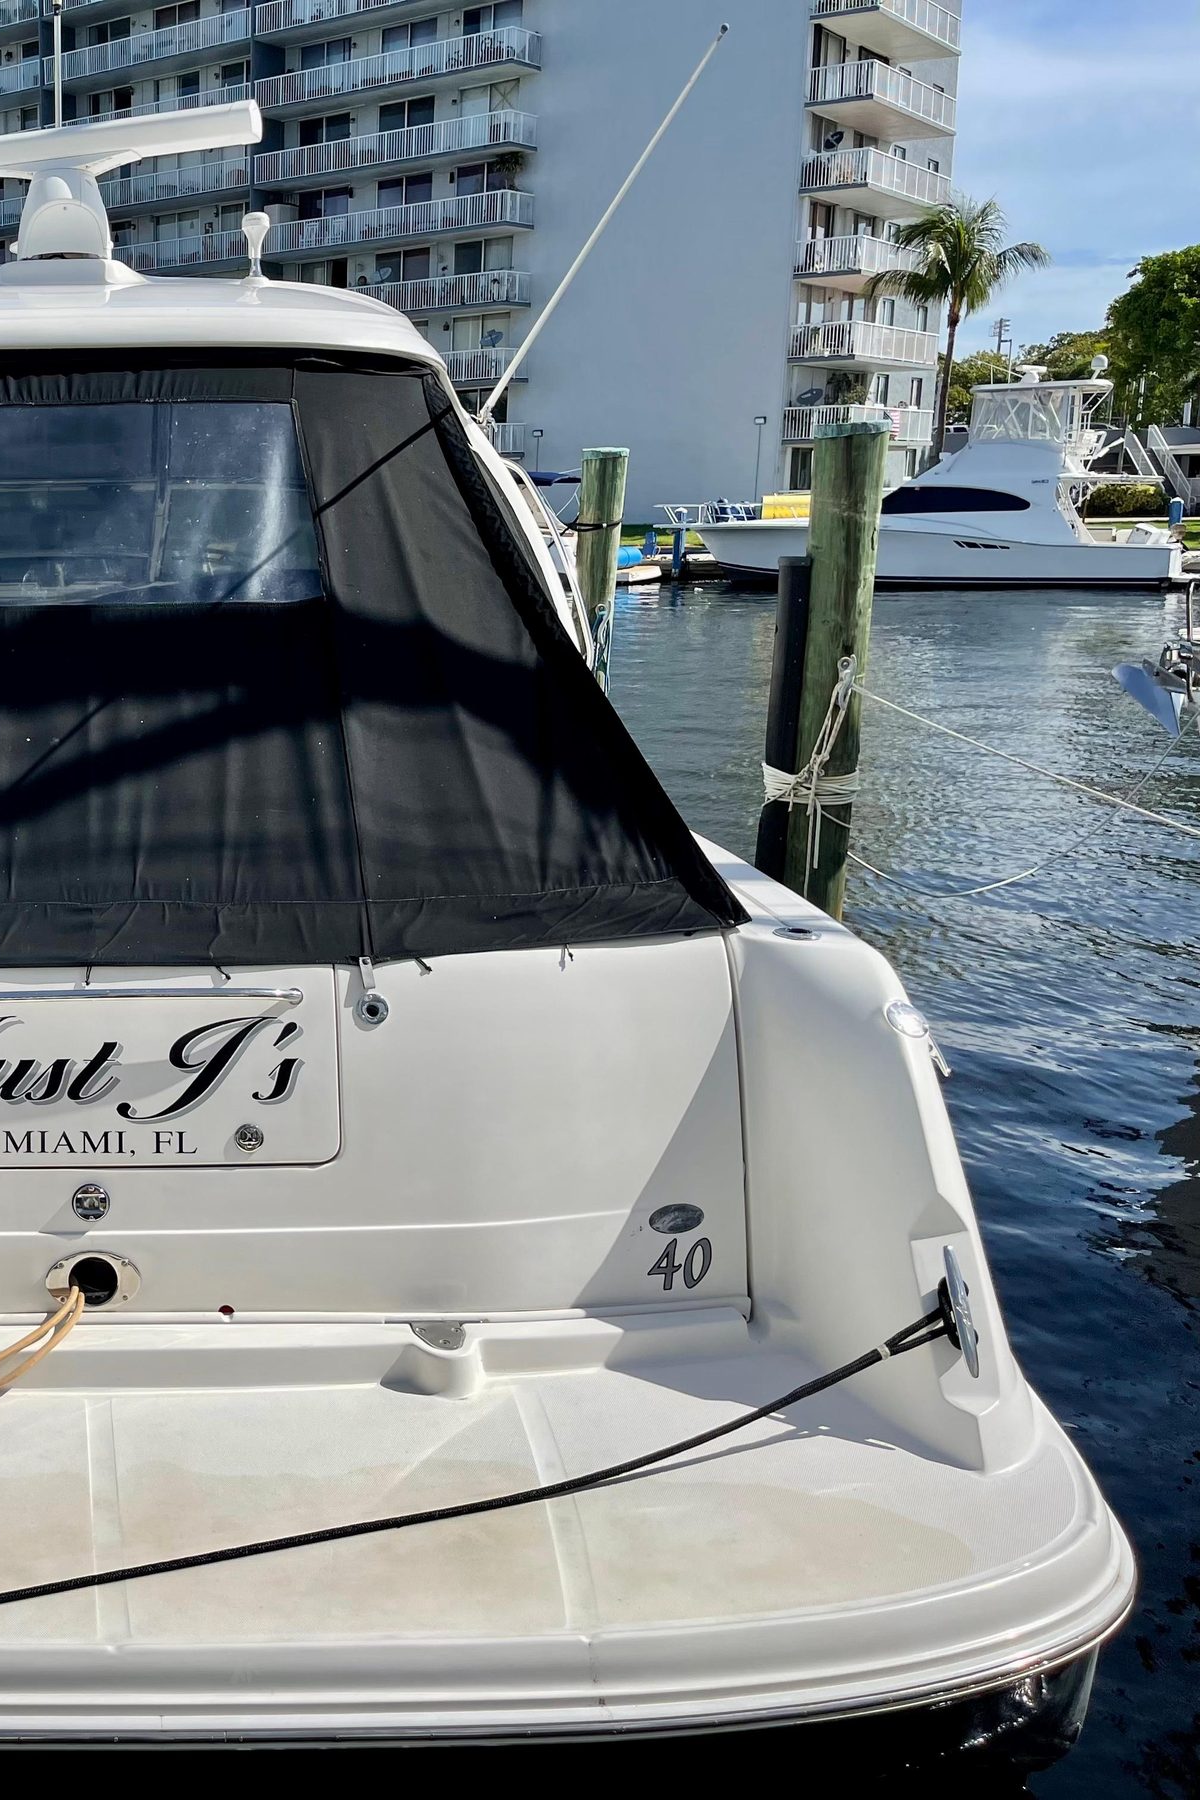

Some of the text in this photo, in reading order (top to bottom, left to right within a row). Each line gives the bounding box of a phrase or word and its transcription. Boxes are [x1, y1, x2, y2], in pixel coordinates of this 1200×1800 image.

[2, 1130, 198, 1157] MIAMI, FL
[647, 1237, 712, 1291] 40
